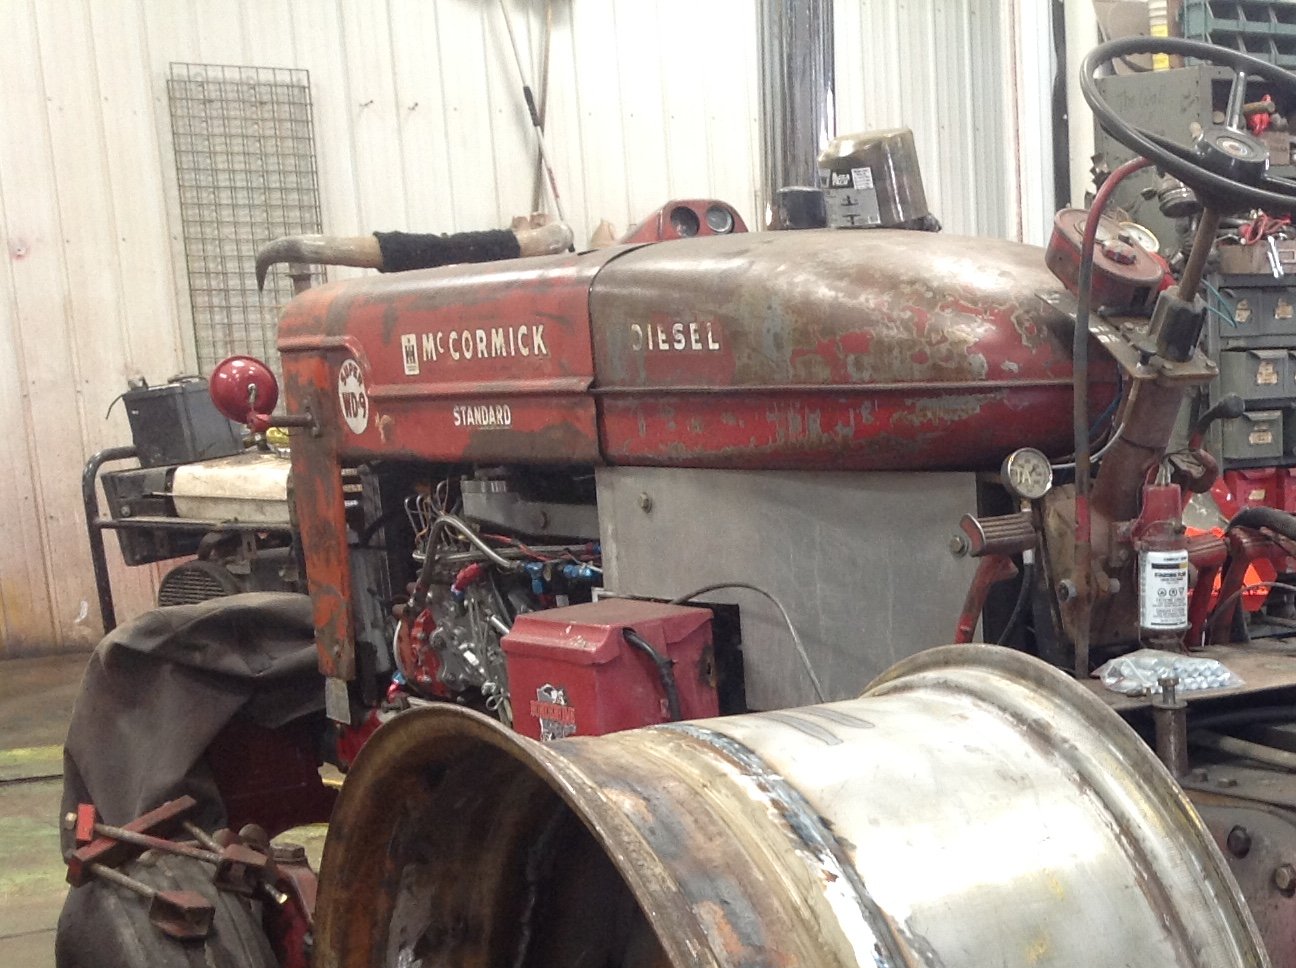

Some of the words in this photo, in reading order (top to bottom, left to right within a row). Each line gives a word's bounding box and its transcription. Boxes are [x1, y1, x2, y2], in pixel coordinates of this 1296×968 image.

[631, 322, 720, 350] DIESEL
[340, 362, 363, 386] SUPER
[453, 404, 511, 426] STANDARD
